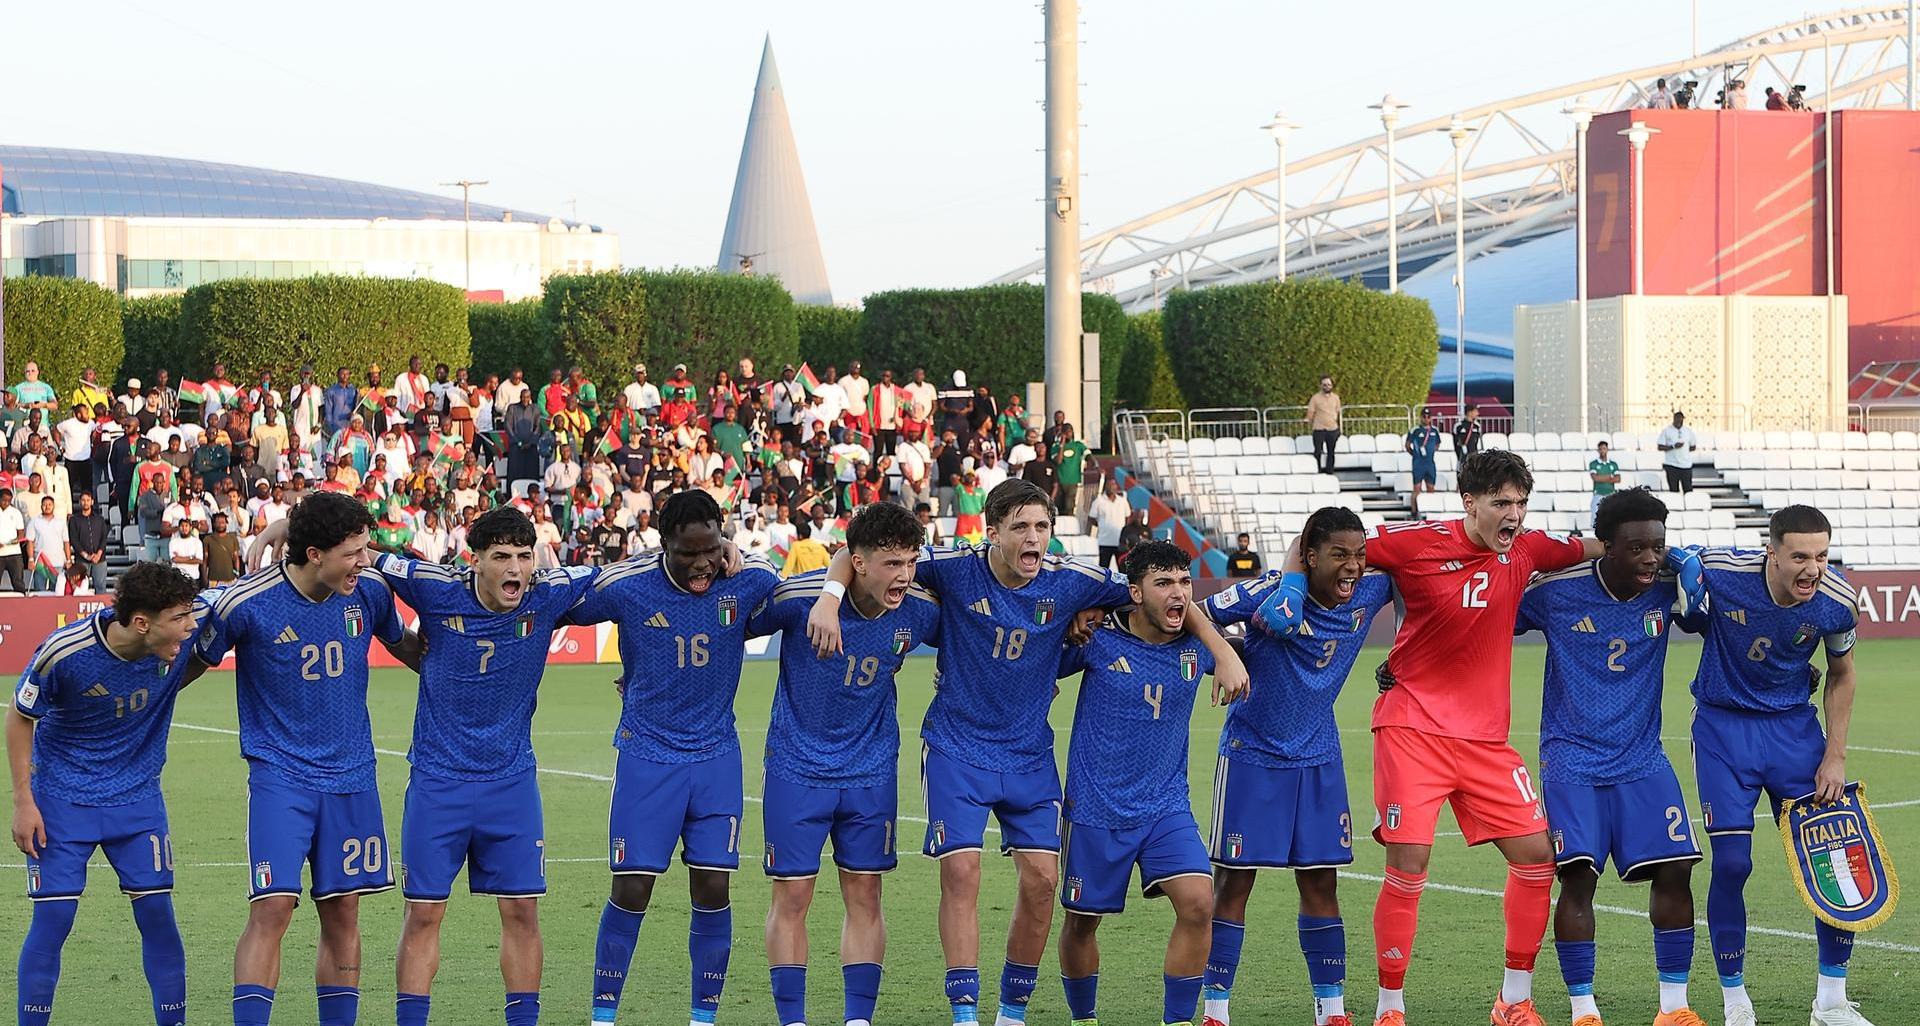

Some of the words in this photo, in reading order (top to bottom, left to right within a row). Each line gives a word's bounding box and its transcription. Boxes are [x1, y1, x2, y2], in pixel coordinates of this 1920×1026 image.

[1593, 172, 1618, 252] 7
[1462, 571, 1489, 608] 12
[301, 640, 344, 680] 20
[476, 640, 495, 674] 7
[674, 633, 710, 668] 16
[992, 626, 1028, 660] 18
[1316, 639, 1339, 669] 3
[1608, 638, 1627, 672] 2
[1747, 636, 1773, 662] 6
[843, 655, 880, 687] 19
[114, 688, 149, 718] 10
[1144, 684, 1163, 720] 4
[1512, 766, 1537, 803] 12
[728, 816, 742, 853] 1
[884, 820, 899, 856] 1
[1339, 812, 1351, 848] 3
[1665, 806, 1687, 842] 2
[1804, 818, 1858, 847] ITALIA
[343, 836, 382, 876] 20
[596, 968, 623, 979] ITALIA
[946, 978, 976, 989] ITALIA
